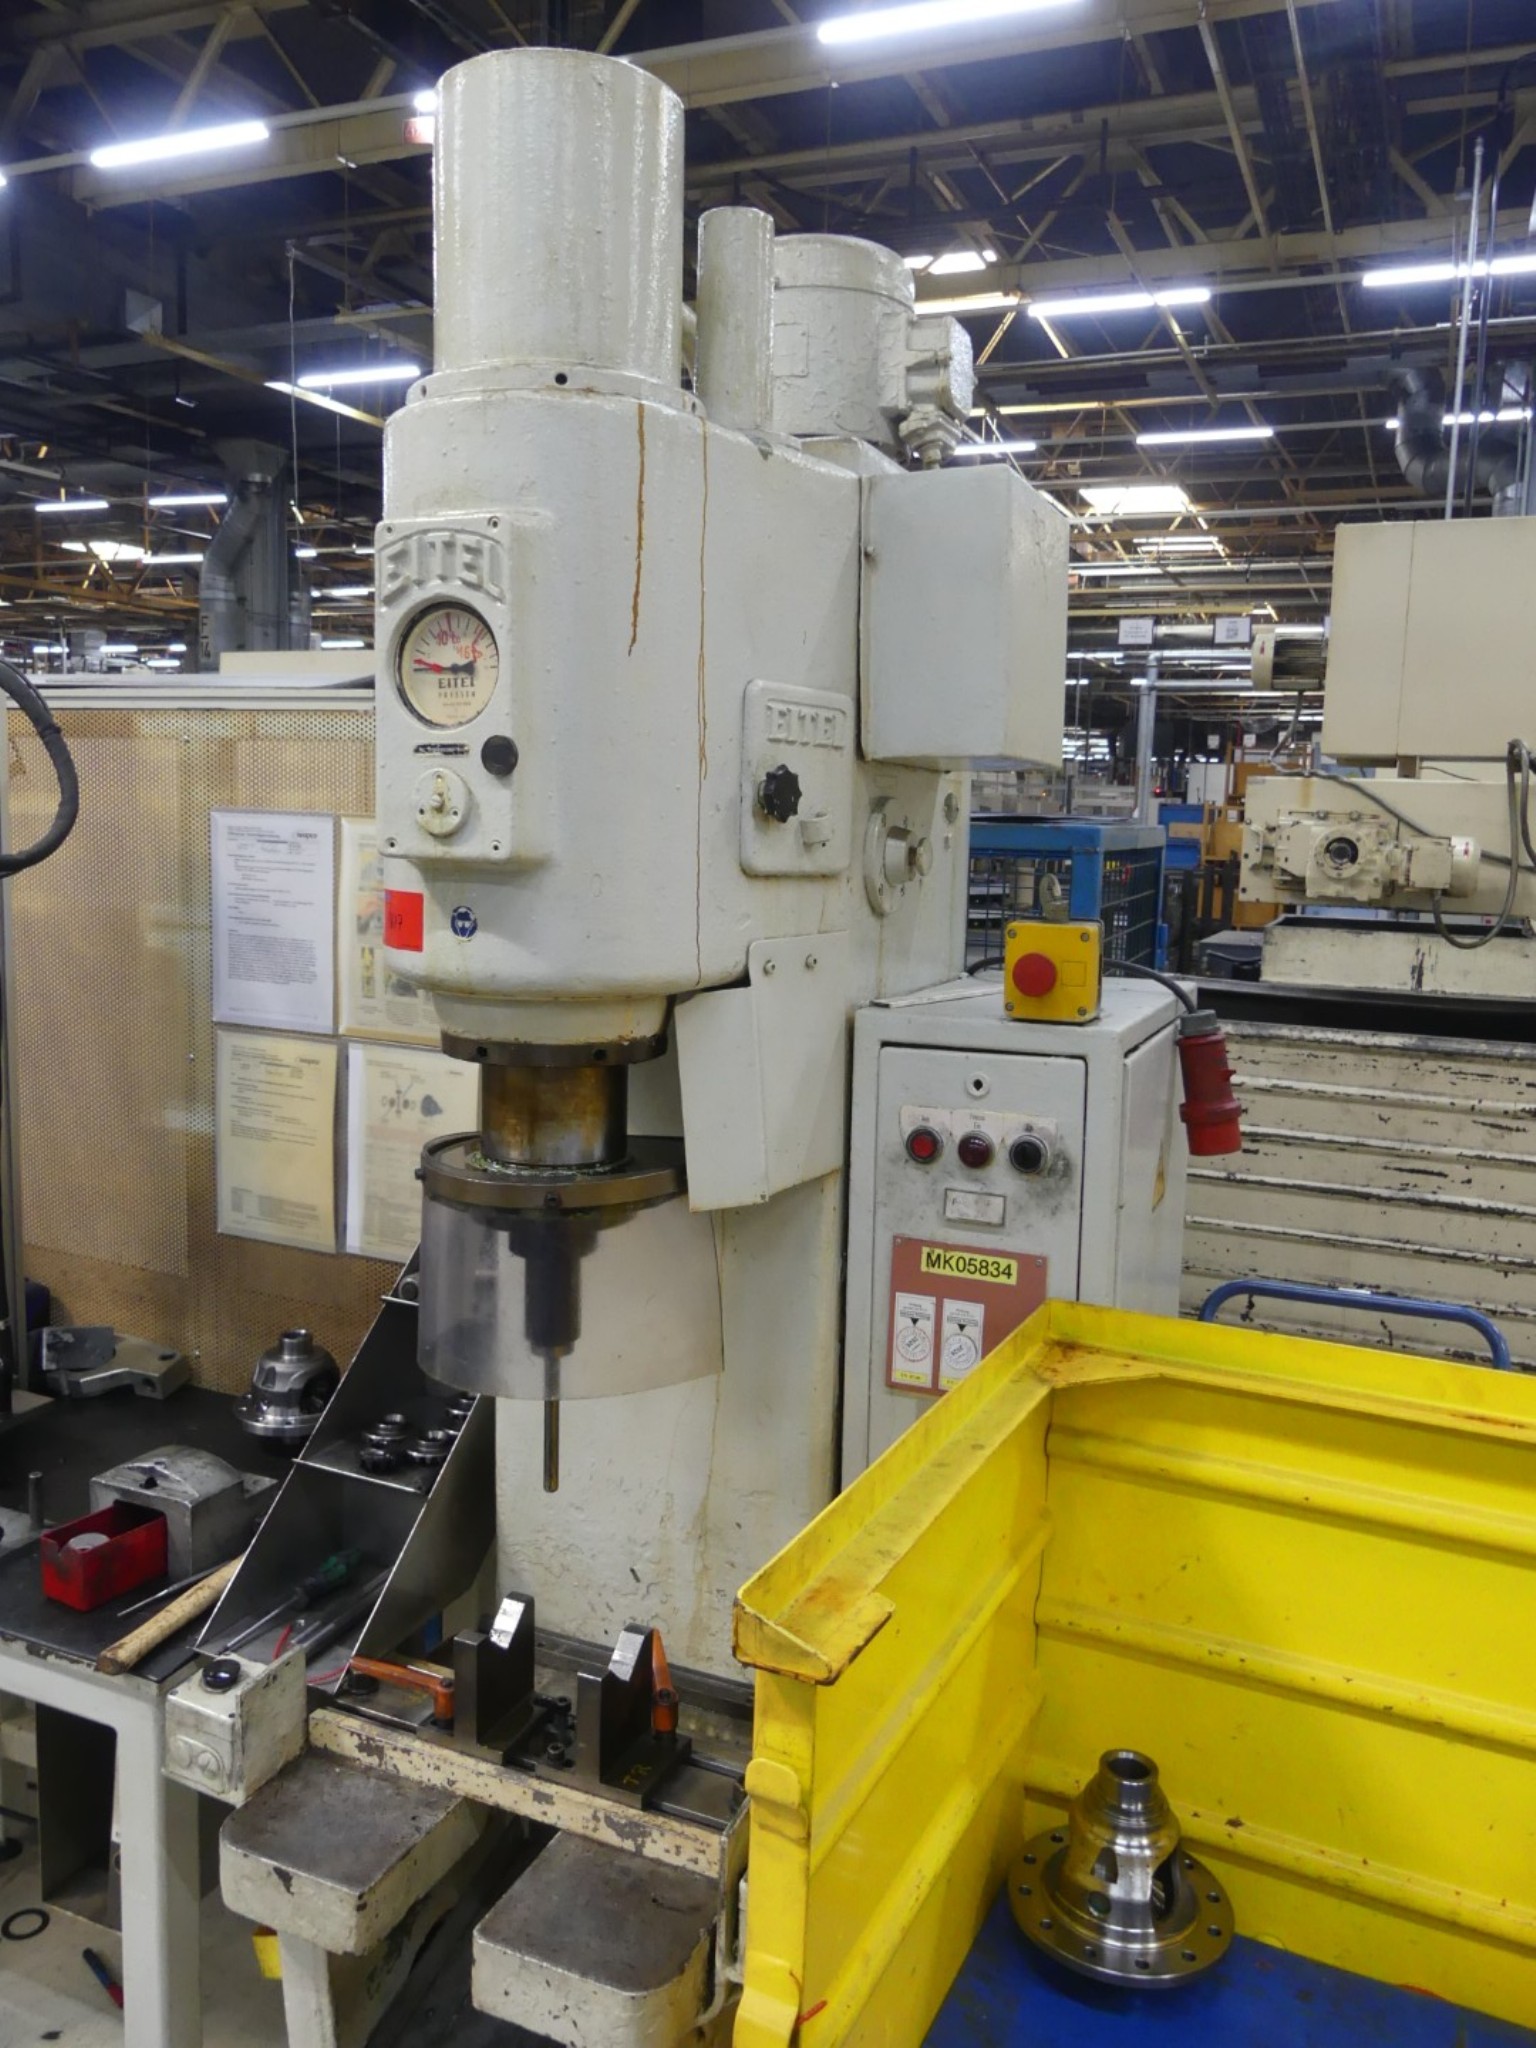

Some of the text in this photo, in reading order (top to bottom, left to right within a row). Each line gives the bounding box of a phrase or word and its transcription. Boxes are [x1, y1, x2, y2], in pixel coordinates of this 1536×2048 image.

[382, 533, 505, 606] EITEL
[438, 677, 475, 689] EITEL
[925, 1251, 1013, 1280] MK05834
